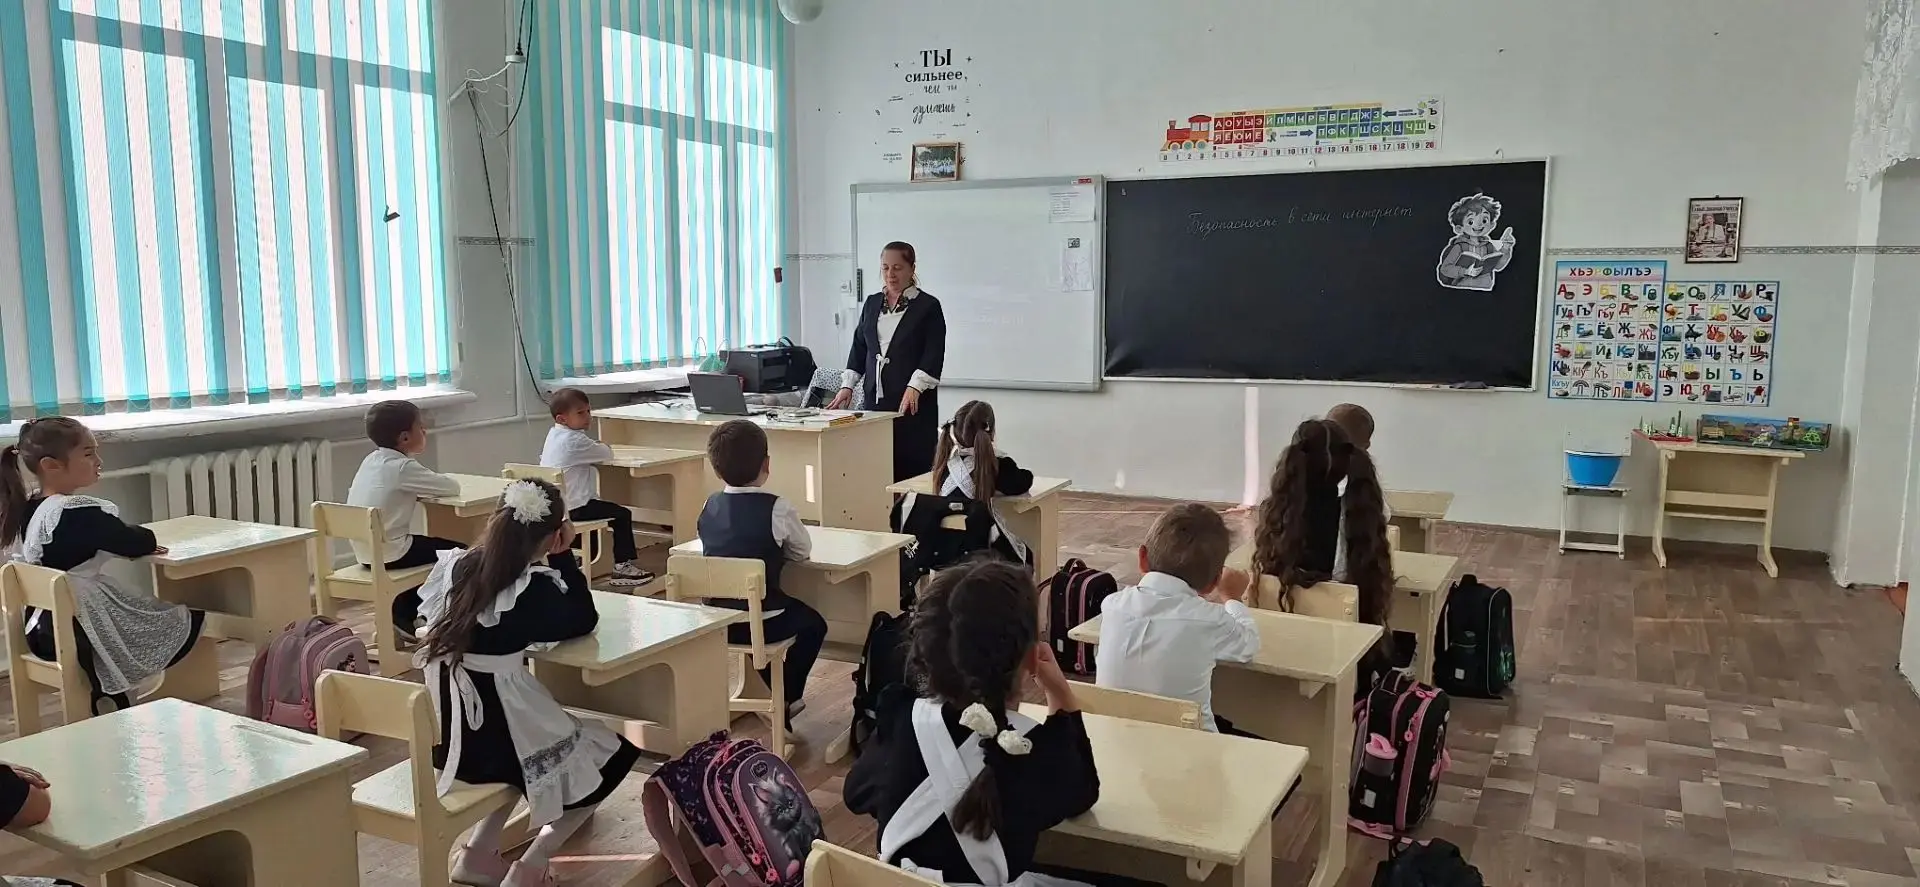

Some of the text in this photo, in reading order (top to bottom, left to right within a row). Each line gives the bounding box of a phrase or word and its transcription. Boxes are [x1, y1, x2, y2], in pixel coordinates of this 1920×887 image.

[920, 48, 951, 67] ТЫ
[924, 85, 940, 94] чем
[912, 104, 955, 124] думаешь
[1288, 207, 1298, 224] в
[1301, 208, 1332, 223] сети
[1558, 284, 1567, 295] А
[1583, 284, 1592, 295] Э
[1622, 284, 1631, 295] В
[1643, 284, 1651, 295] Г
[1756, 284, 1766, 296] Р
[1619, 303, 1629, 315] Д
[1688, 304, 1698, 315] Т
[1618, 323, 1630, 333] Ж
[1706, 368, 1720, 380] Ы
[1730, 369, 1742, 380] Ъ
[1753, 369, 1763, 380] Ь
[1663, 385, 1673, 396] Э
[1681, 384, 1692, 395] Ю
